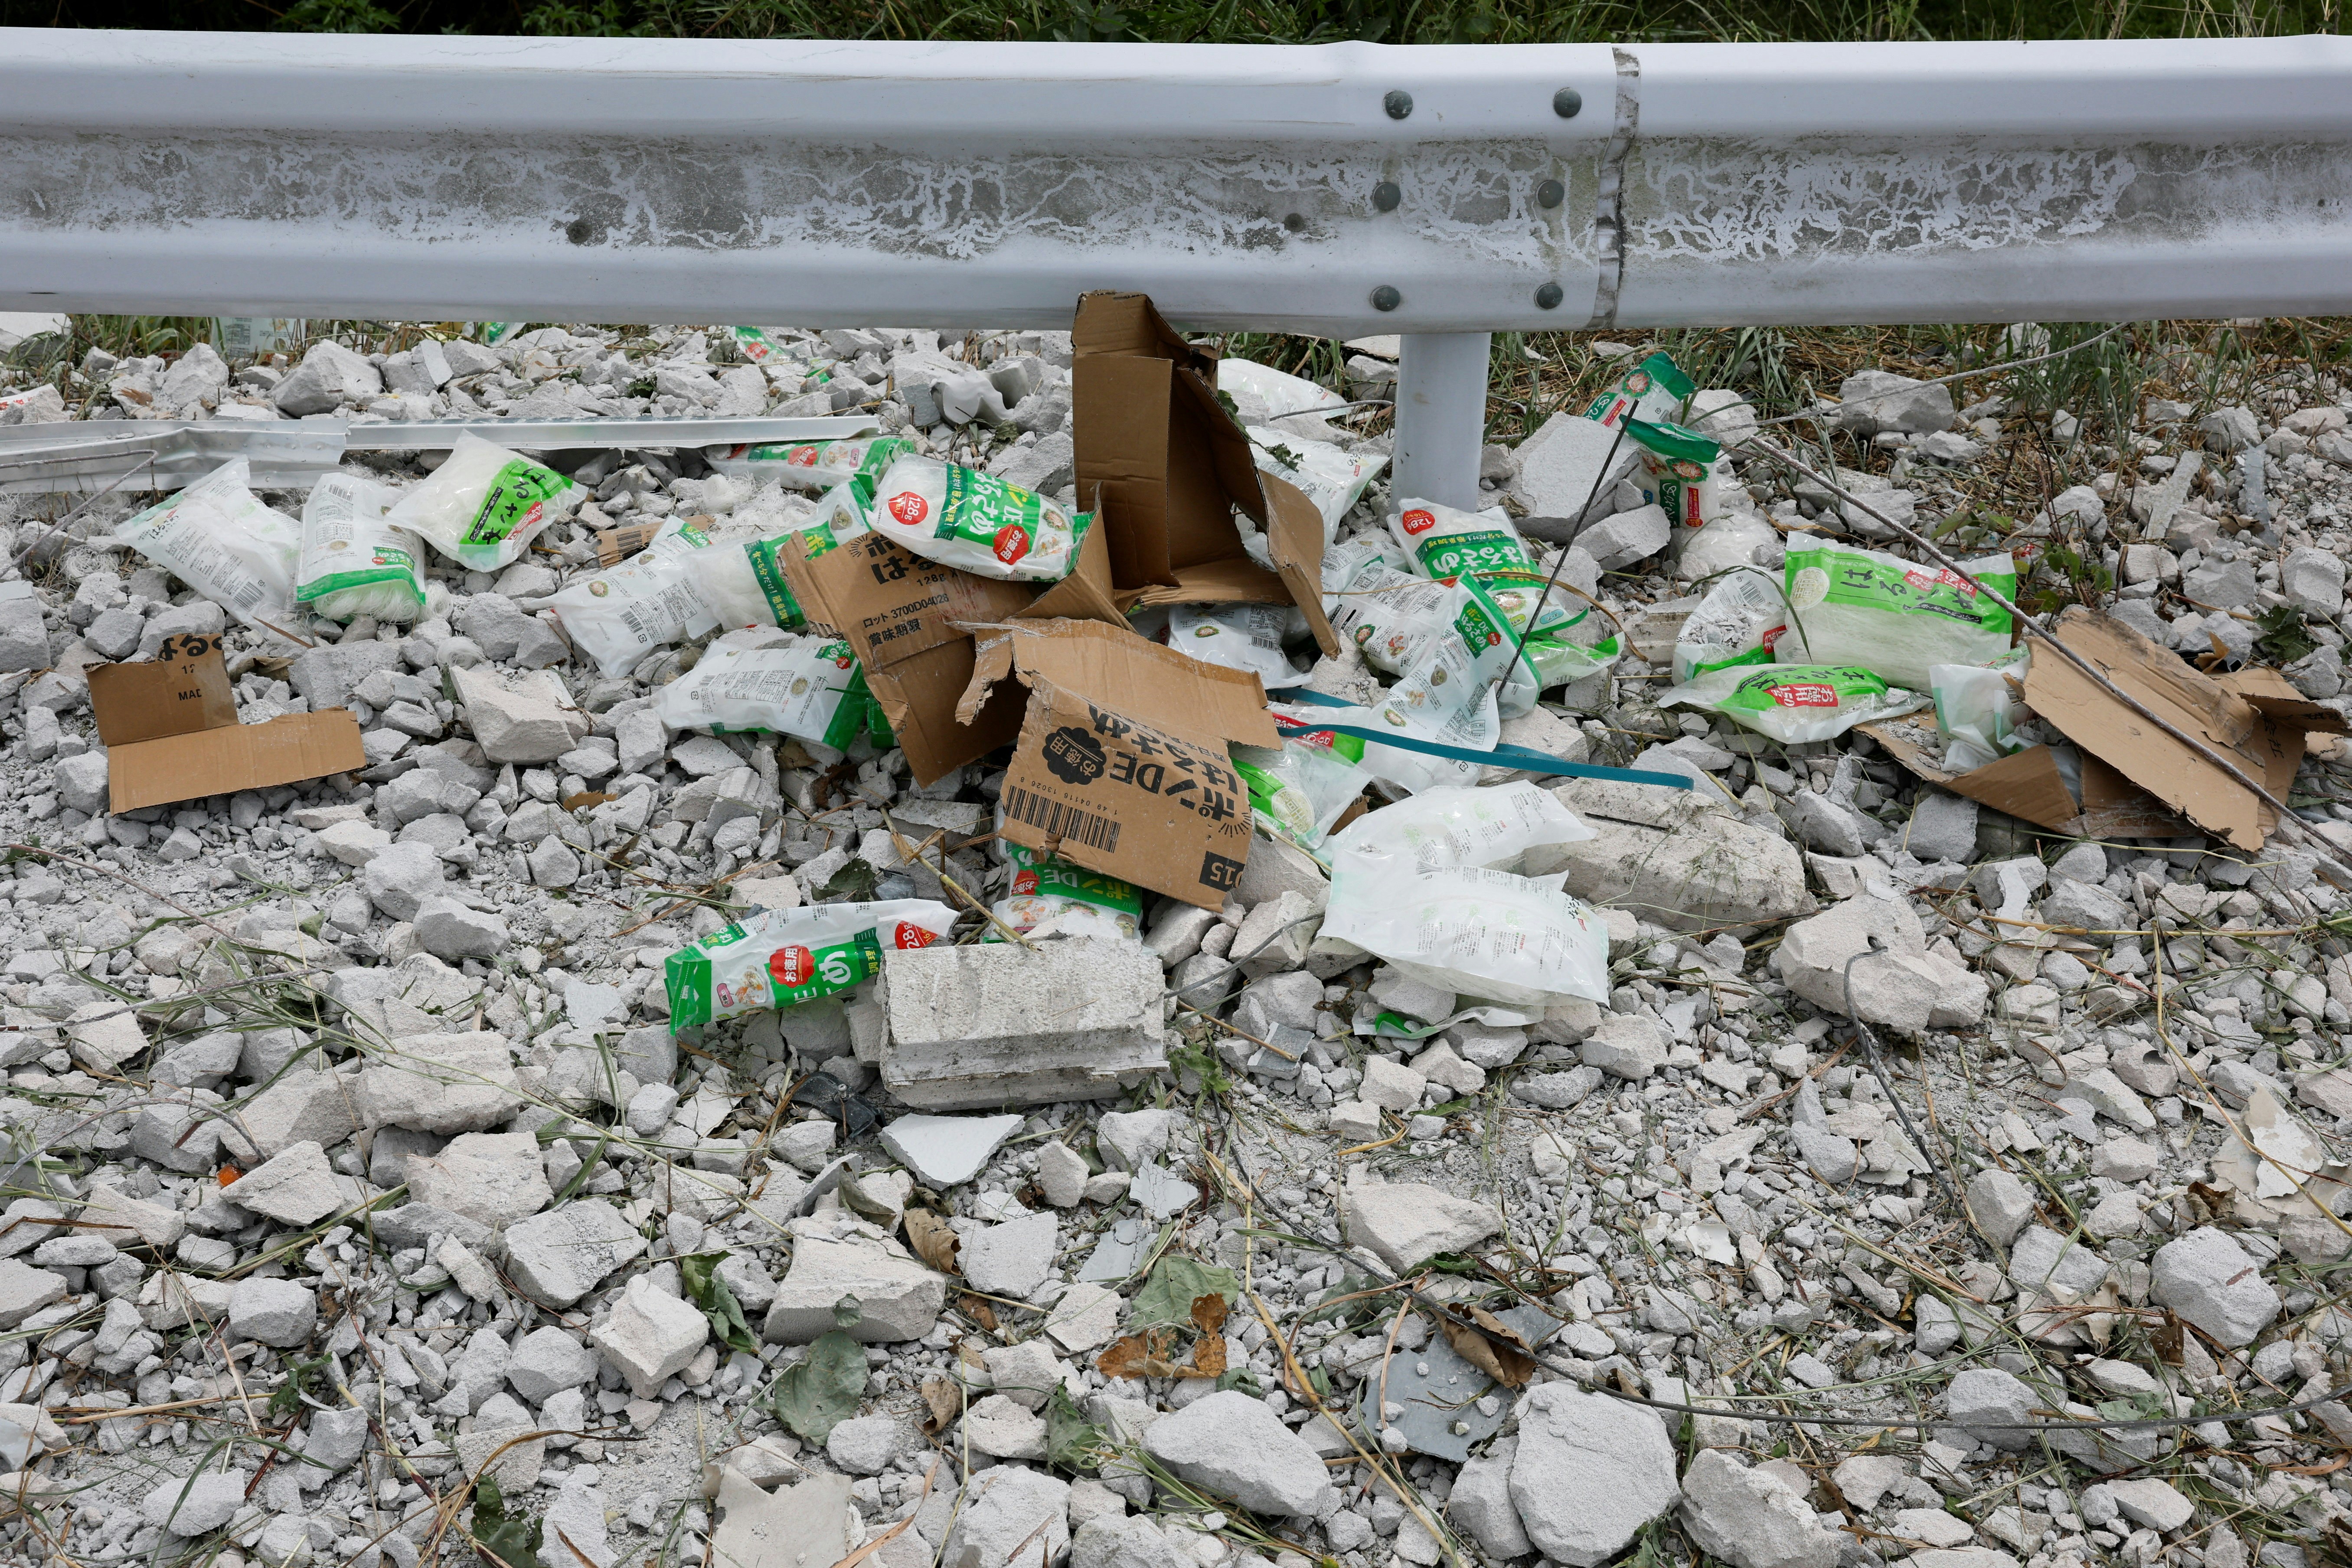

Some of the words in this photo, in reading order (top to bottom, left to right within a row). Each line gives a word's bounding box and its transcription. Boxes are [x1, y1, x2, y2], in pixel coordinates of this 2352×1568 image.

[904, 496, 923, 521] 128g
[968, 471, 1002, 535] はるさめ
[1407, 517, 1432, 531] 128g
[1000, 529, 1023, 560] お徳用
[1432, 547, 1529, 574] はるさめ
[862, 612, 889, 628] ロット
[868, 618, 921, 647] 賞味期限
[1049, 737, 1097, 777] お徳用
[1088, 702, 1238, 796] はるさめ
[1031, 782, 1057, 795] 13026
[1063, 793, 1091, 807] 04116
[1109, 751, 1235, 822] ポンDE
[1097, 804, 1108, 812] 49
[1044, 869, 1130, 900] ポンDE
[784, 947, 797, 983] お徳用
